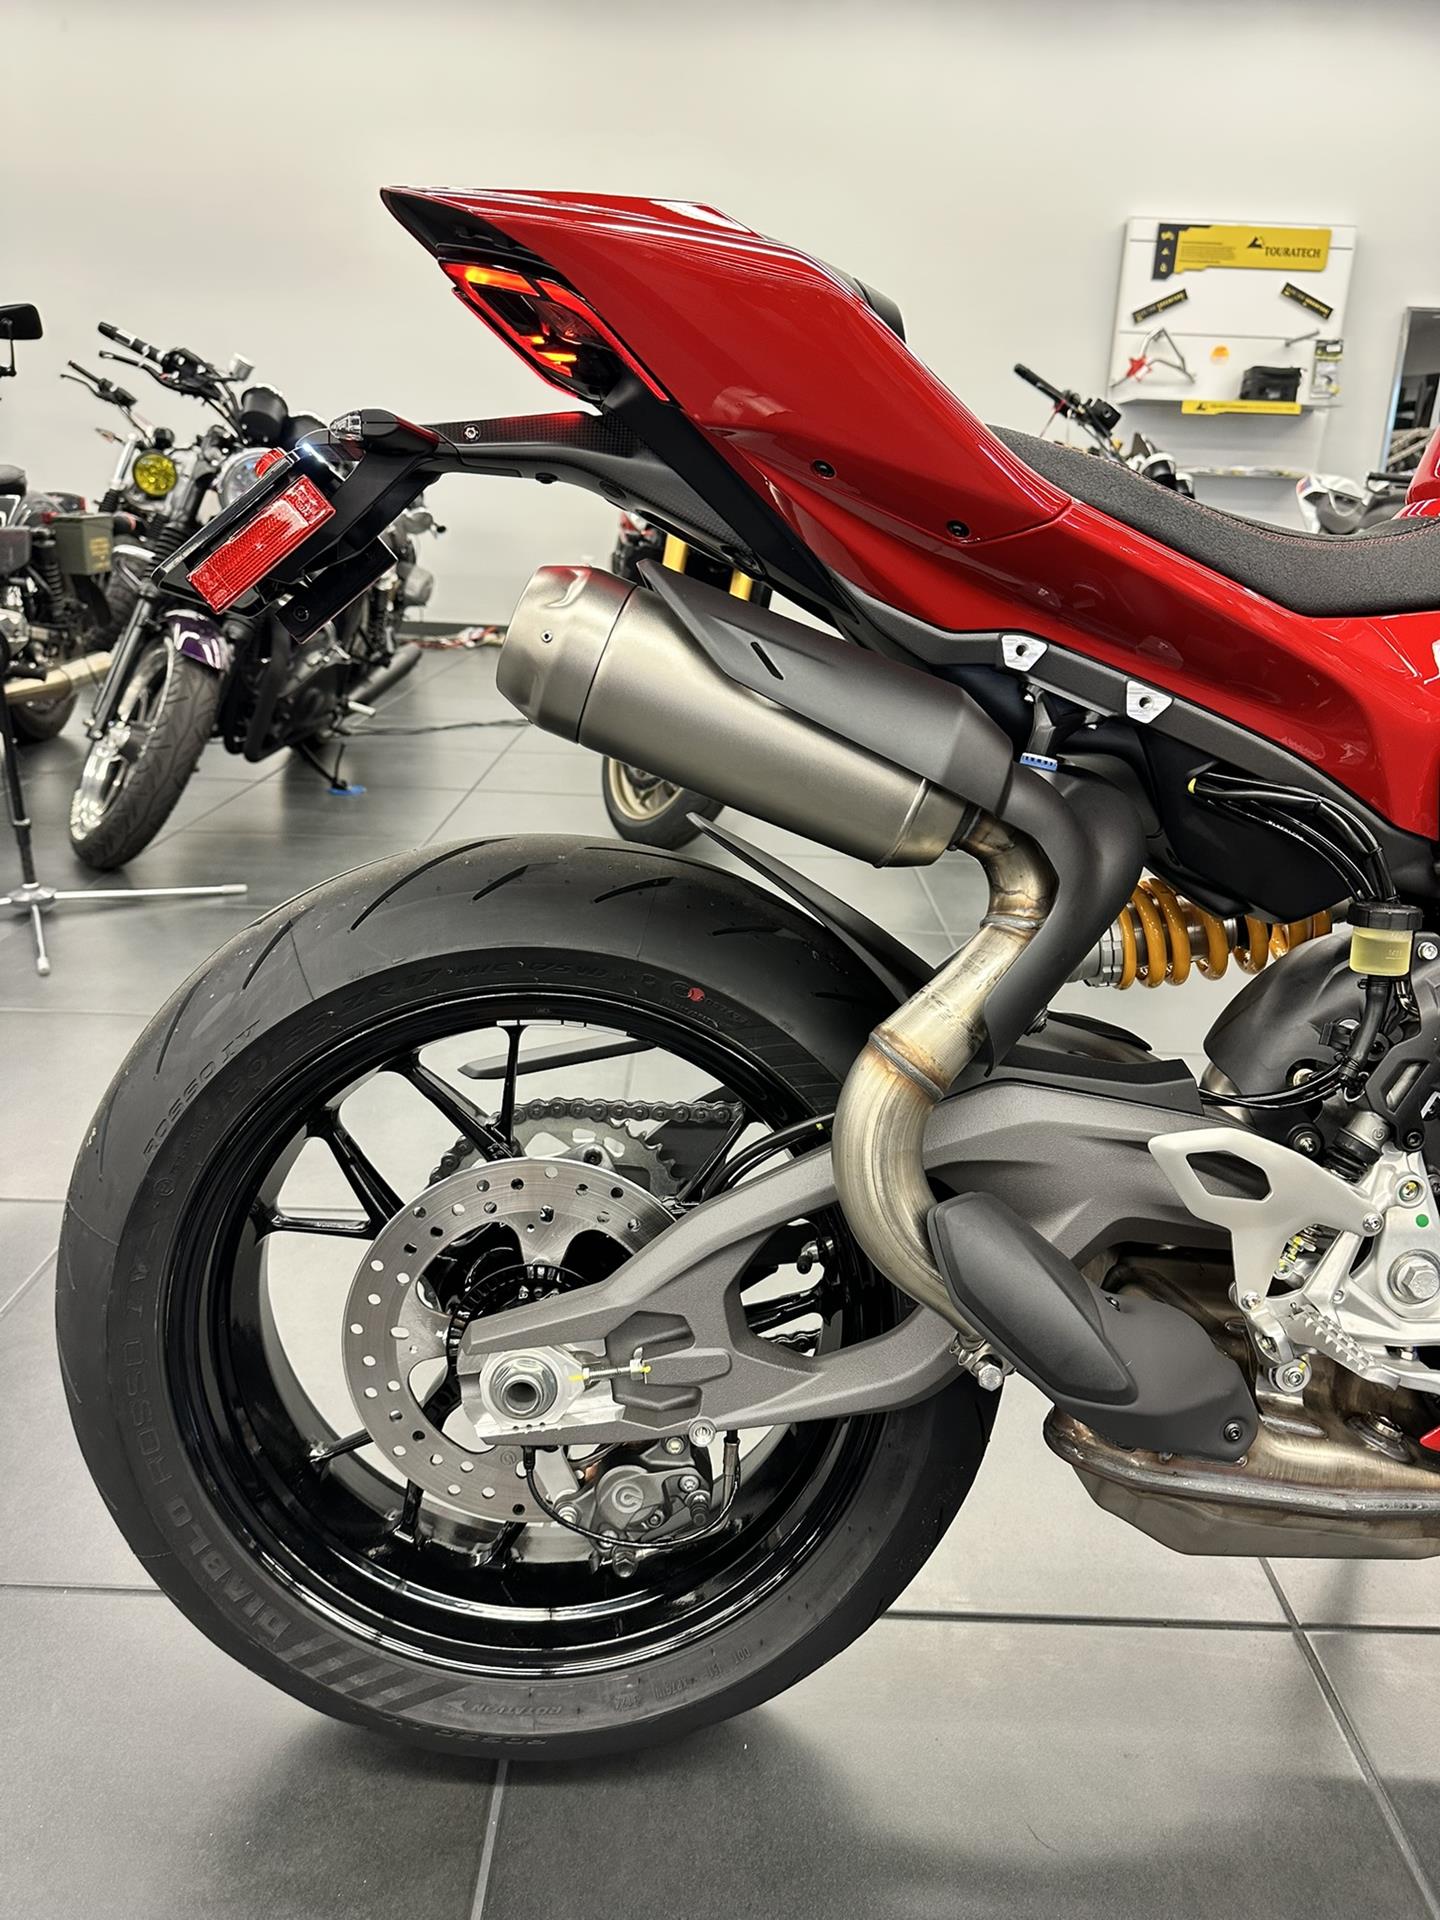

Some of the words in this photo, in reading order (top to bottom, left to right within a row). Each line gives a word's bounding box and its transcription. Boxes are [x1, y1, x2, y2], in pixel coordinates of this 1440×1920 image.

[1265, 246, 1321, 259] TOURATECH
[143, 1061, 216, 1160] ROSSO
[165, 1501, 292, 1643] DIABLO
